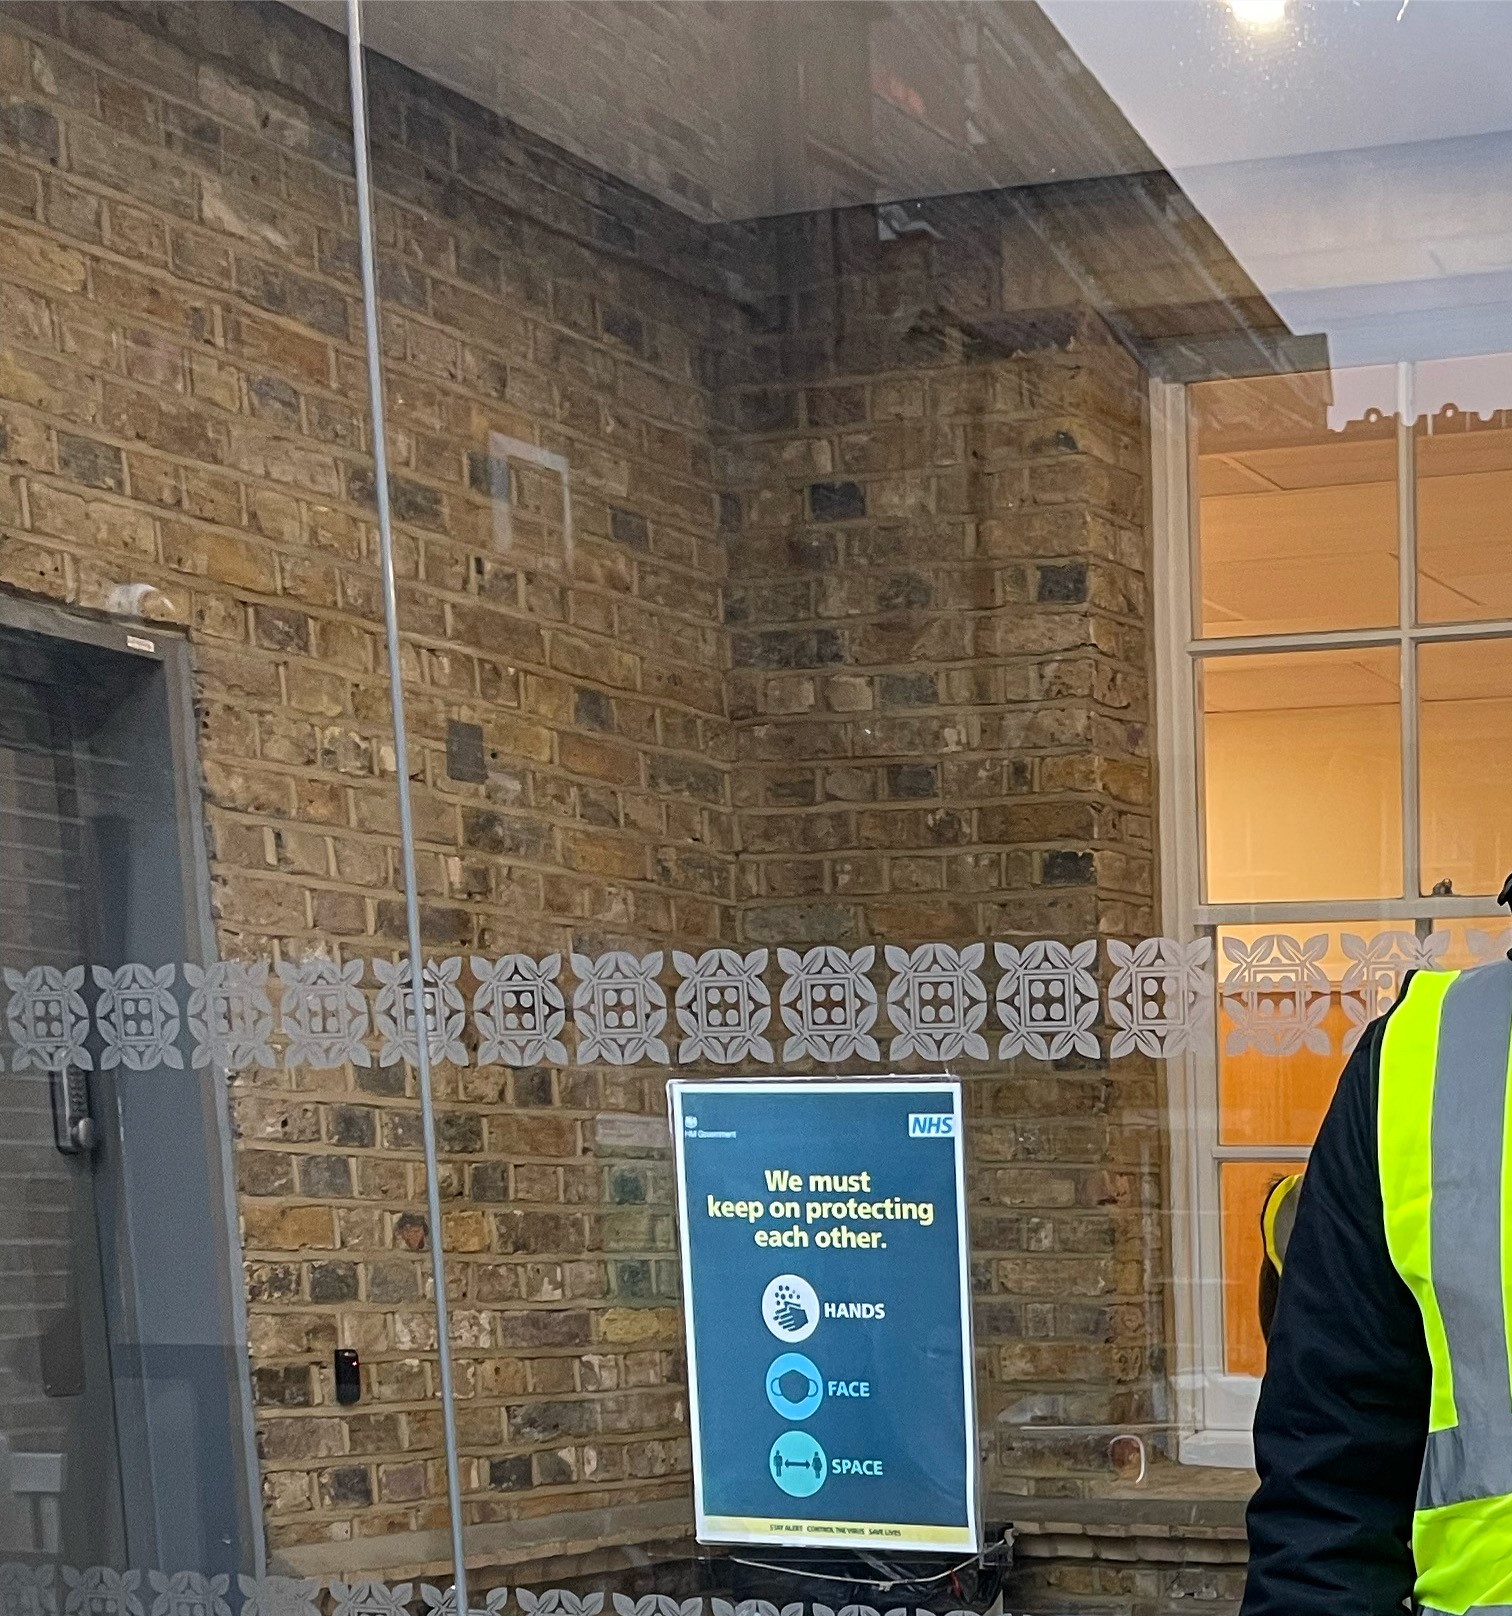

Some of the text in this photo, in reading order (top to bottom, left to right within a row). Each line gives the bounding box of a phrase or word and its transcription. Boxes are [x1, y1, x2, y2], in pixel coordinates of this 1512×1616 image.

[912, 1116, 952, 1135] NHS
[764, 1169, 871, 1193] We must
[707, 1194, 934, 1226] keep on protecting
[754, 1225, 887, 1249] each other.
[824, 1302, 885, 1320] HANDS
[828, 1381, 870, 1397] FACE
[832, 1459, 883, 1476] SPACE
